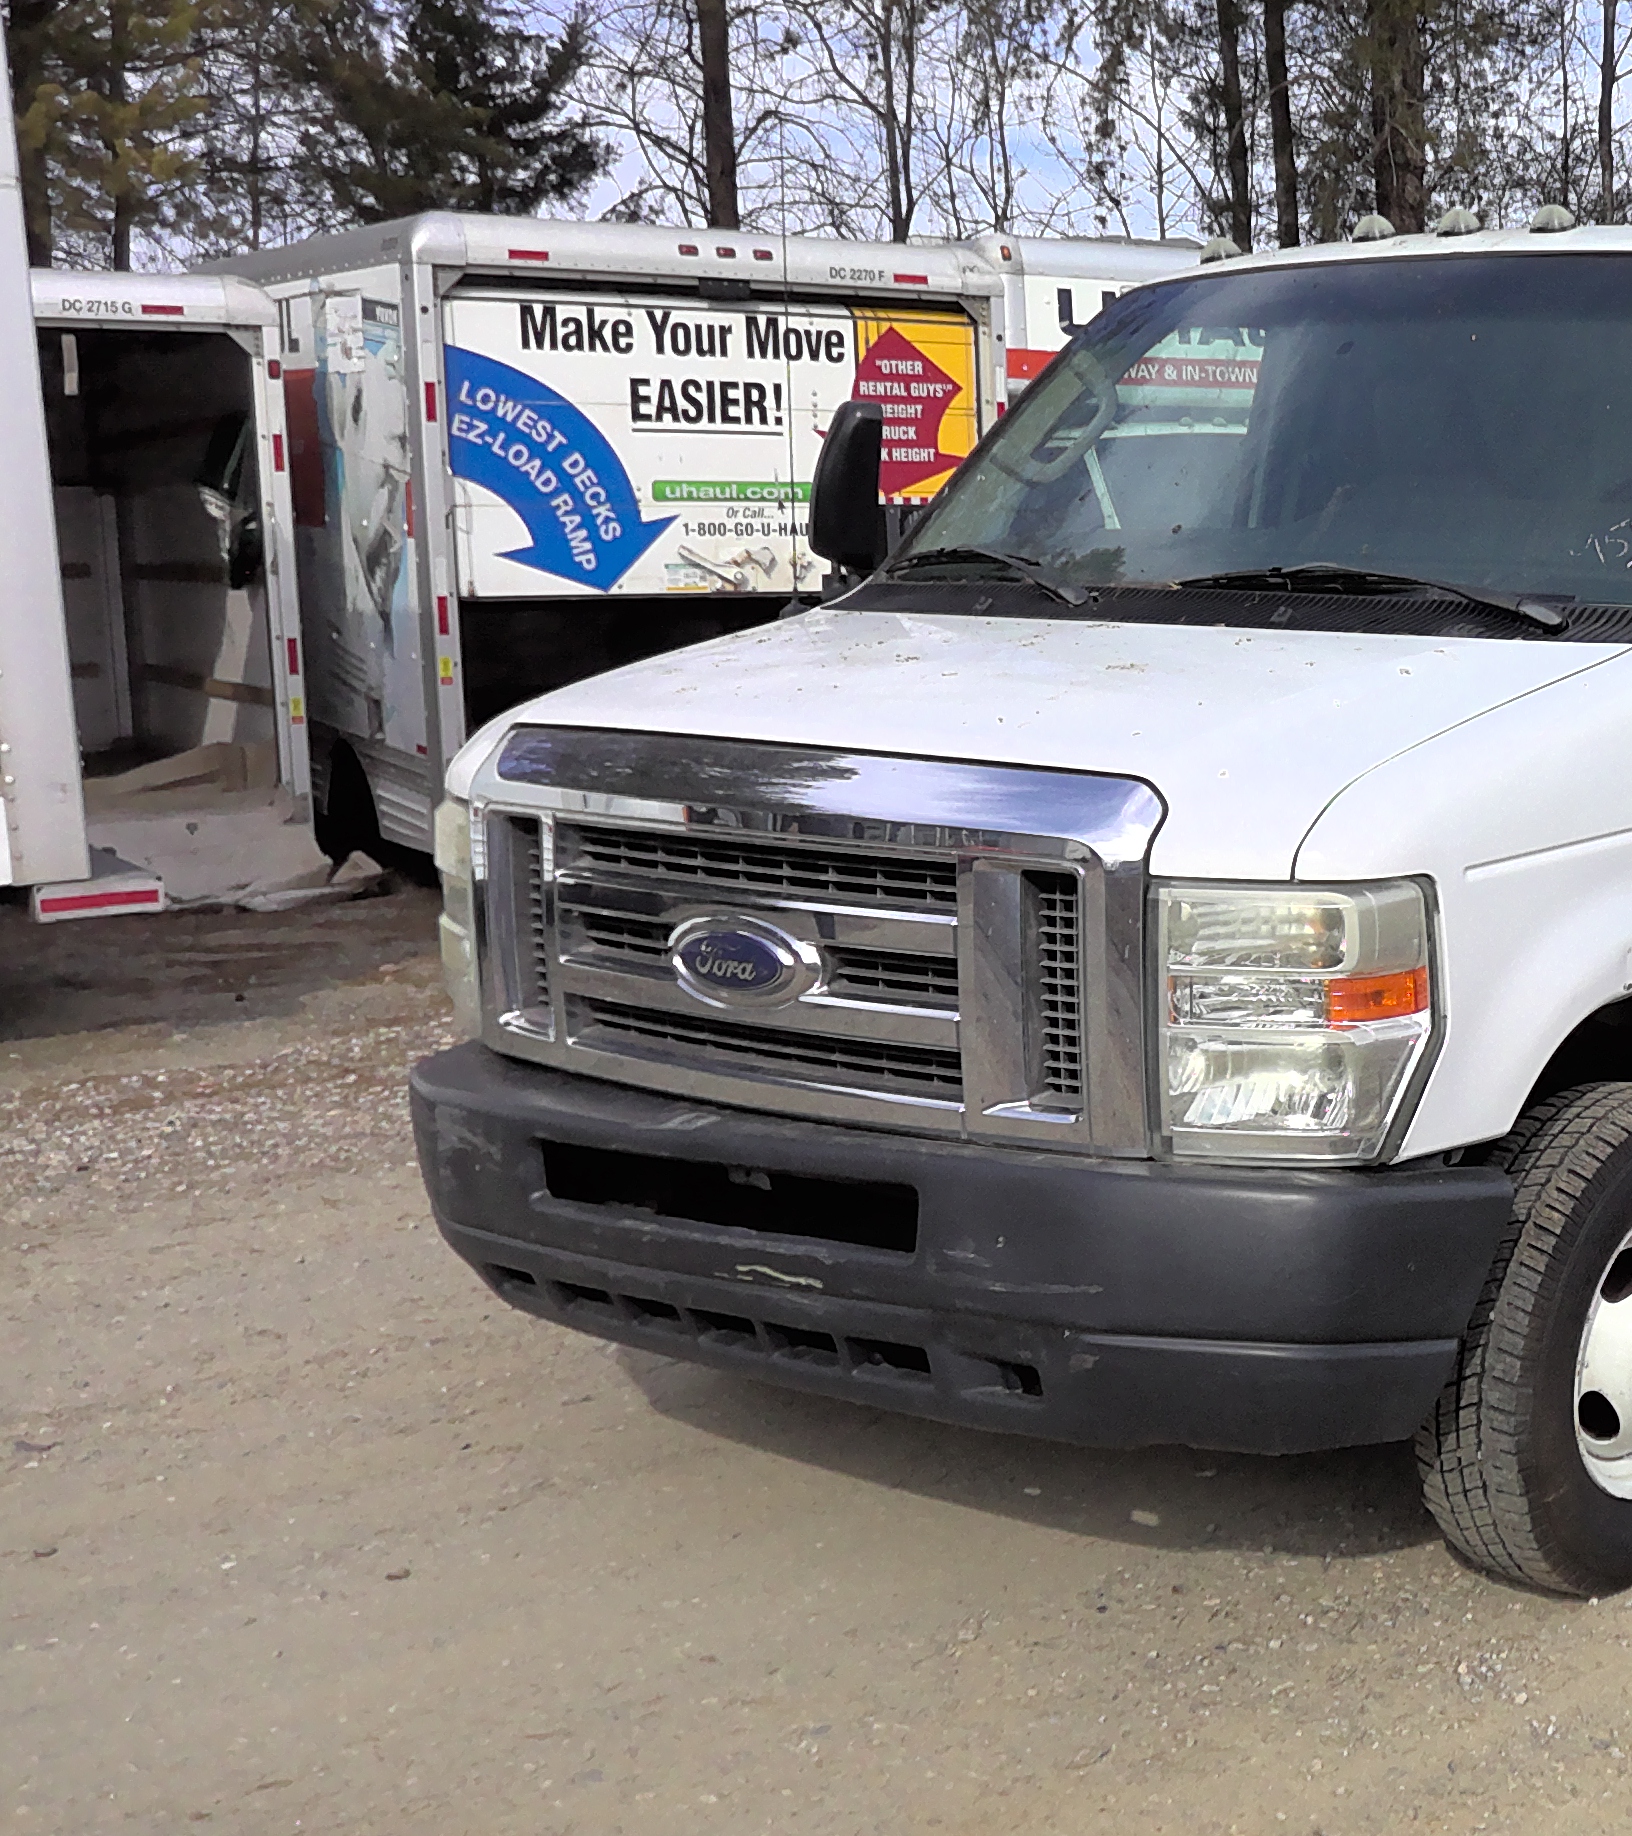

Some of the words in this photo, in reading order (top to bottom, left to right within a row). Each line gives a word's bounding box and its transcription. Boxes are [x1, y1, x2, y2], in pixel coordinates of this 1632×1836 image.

[829, 266, 847, 279] DC
[850, 268, 876, 281] 2270
[878, 270, 885, 282] F
[62, 299, 82, 312] DC
[86, 300, 118, 313] 2715
[121, 301, 133, 314] G
[519, 303, 634, 355] Make
[645, 309, 733, 358] Your
[743, 314, 845, 363] Move
[1164, 364, 1178, 380] &
[1181, 365, 1258, 384] IN-TOWN
[859, 381, 908, 396] RENTAL
[629, 377, 783, 427] EASIER!
[882, 425, 917, 439] RUCK
[459, 380, 568, 452] LOWEST
[561, 452, 621, 542] DECKS
[892, 447, 935, 462] HEIGHT
[451, 413, 559, 493] EZ-LOAD
[551, 493, 597, 571] RAMP
[665, 483, 803, 500] uhaul.com
[726, 507, 739, 518] Or
[683, 522, 810, 537] 1-800-GO-U-HAU
[695, 941, 757, 981] Ford
